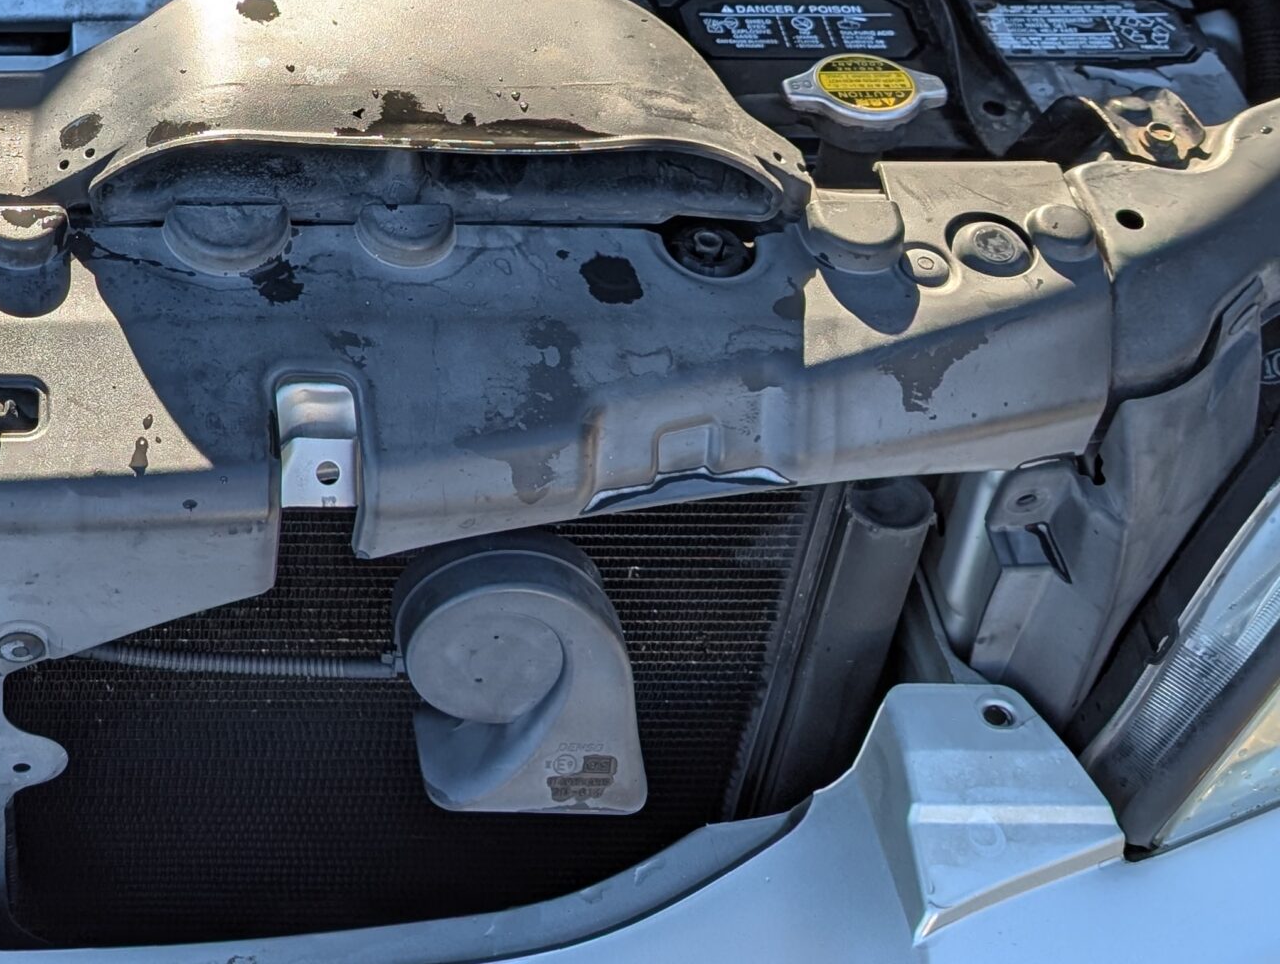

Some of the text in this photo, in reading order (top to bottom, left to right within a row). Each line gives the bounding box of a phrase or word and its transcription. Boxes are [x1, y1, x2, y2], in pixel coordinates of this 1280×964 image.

[735, 5, 794, 14] DANGER
[808, 5, 862, 14] POISON
[558, 742, 604, 752] DENSO
